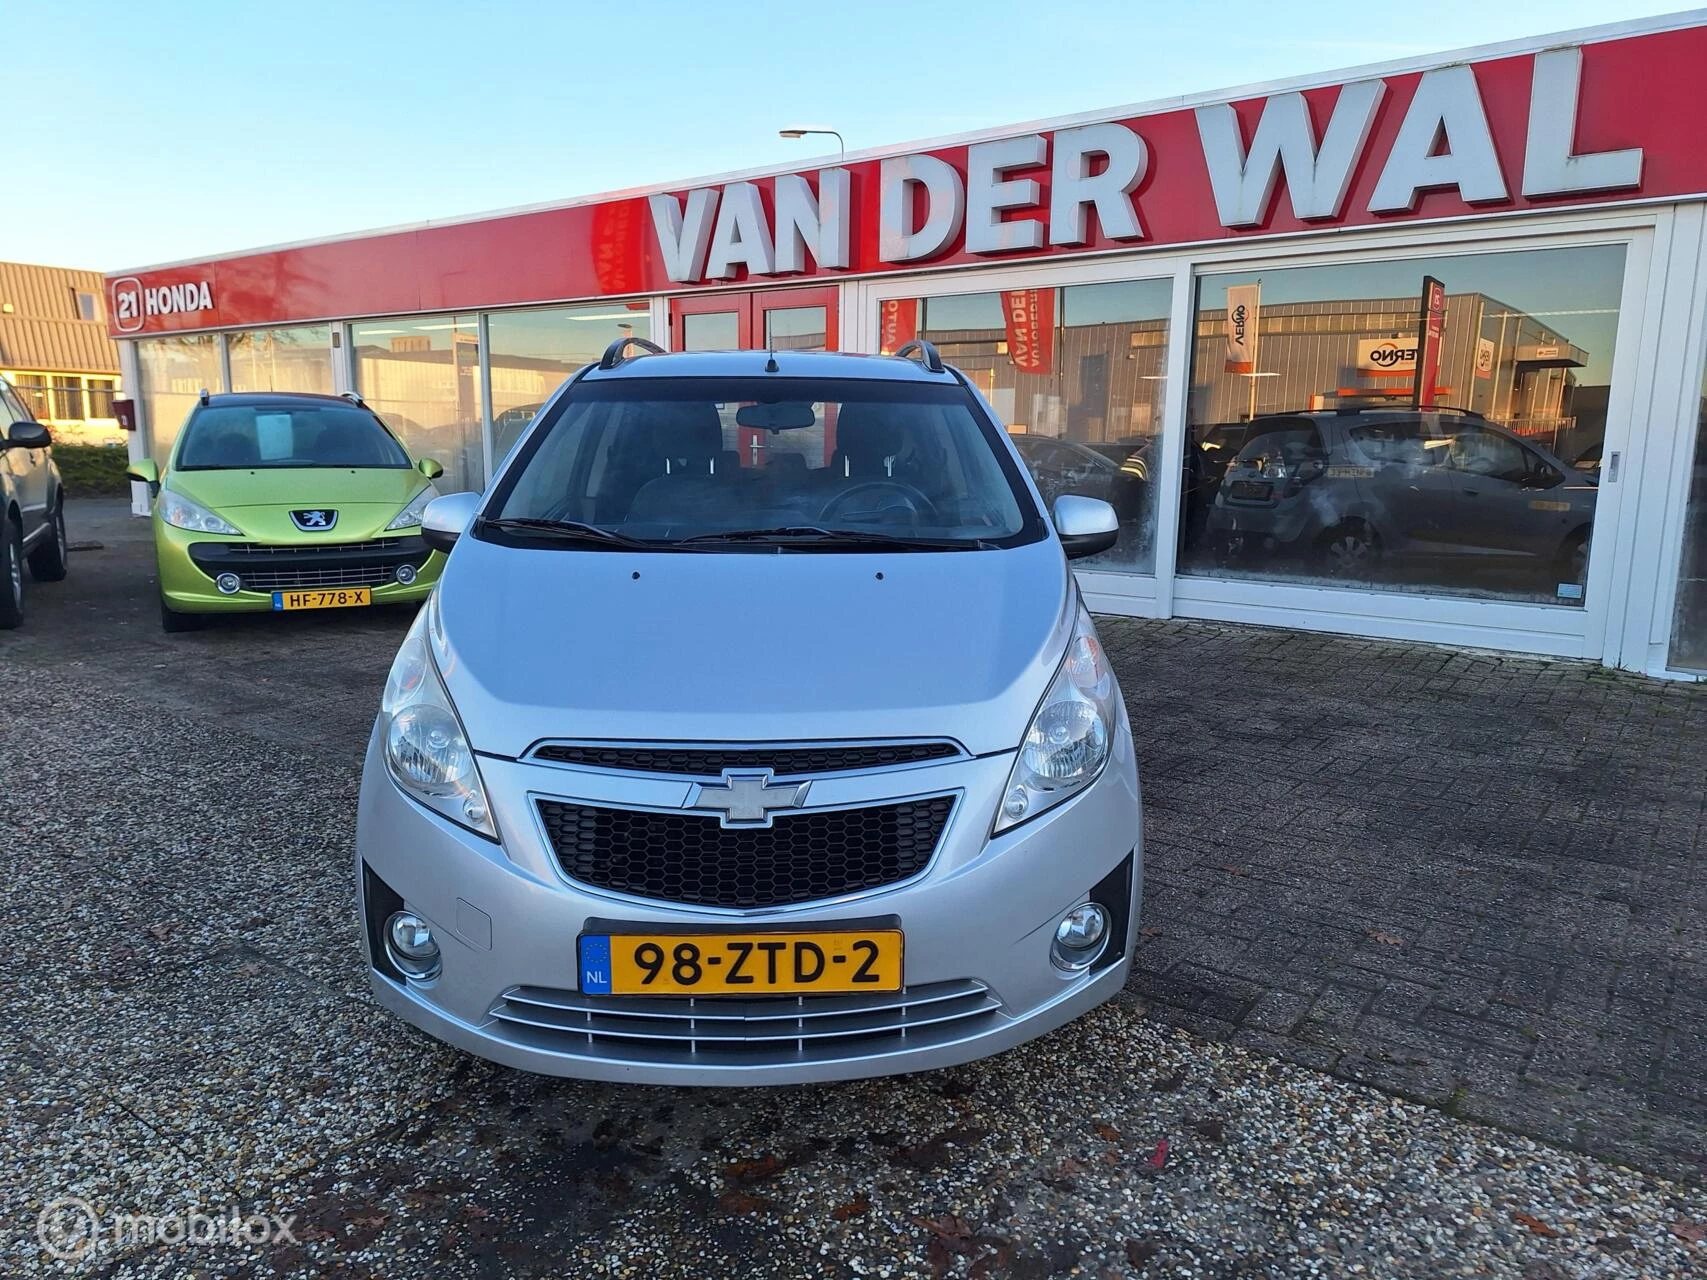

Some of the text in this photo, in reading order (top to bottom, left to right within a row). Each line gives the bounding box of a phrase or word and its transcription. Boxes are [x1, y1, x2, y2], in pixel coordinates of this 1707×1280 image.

[648, 46, 1644, 283] VAN DER WAL
[117, 281, 214, 318] 21 HONDA
[290, 591, 364, 607] HF-778-X
[586, 940, 880, 985] NL 98-ZTD-2
